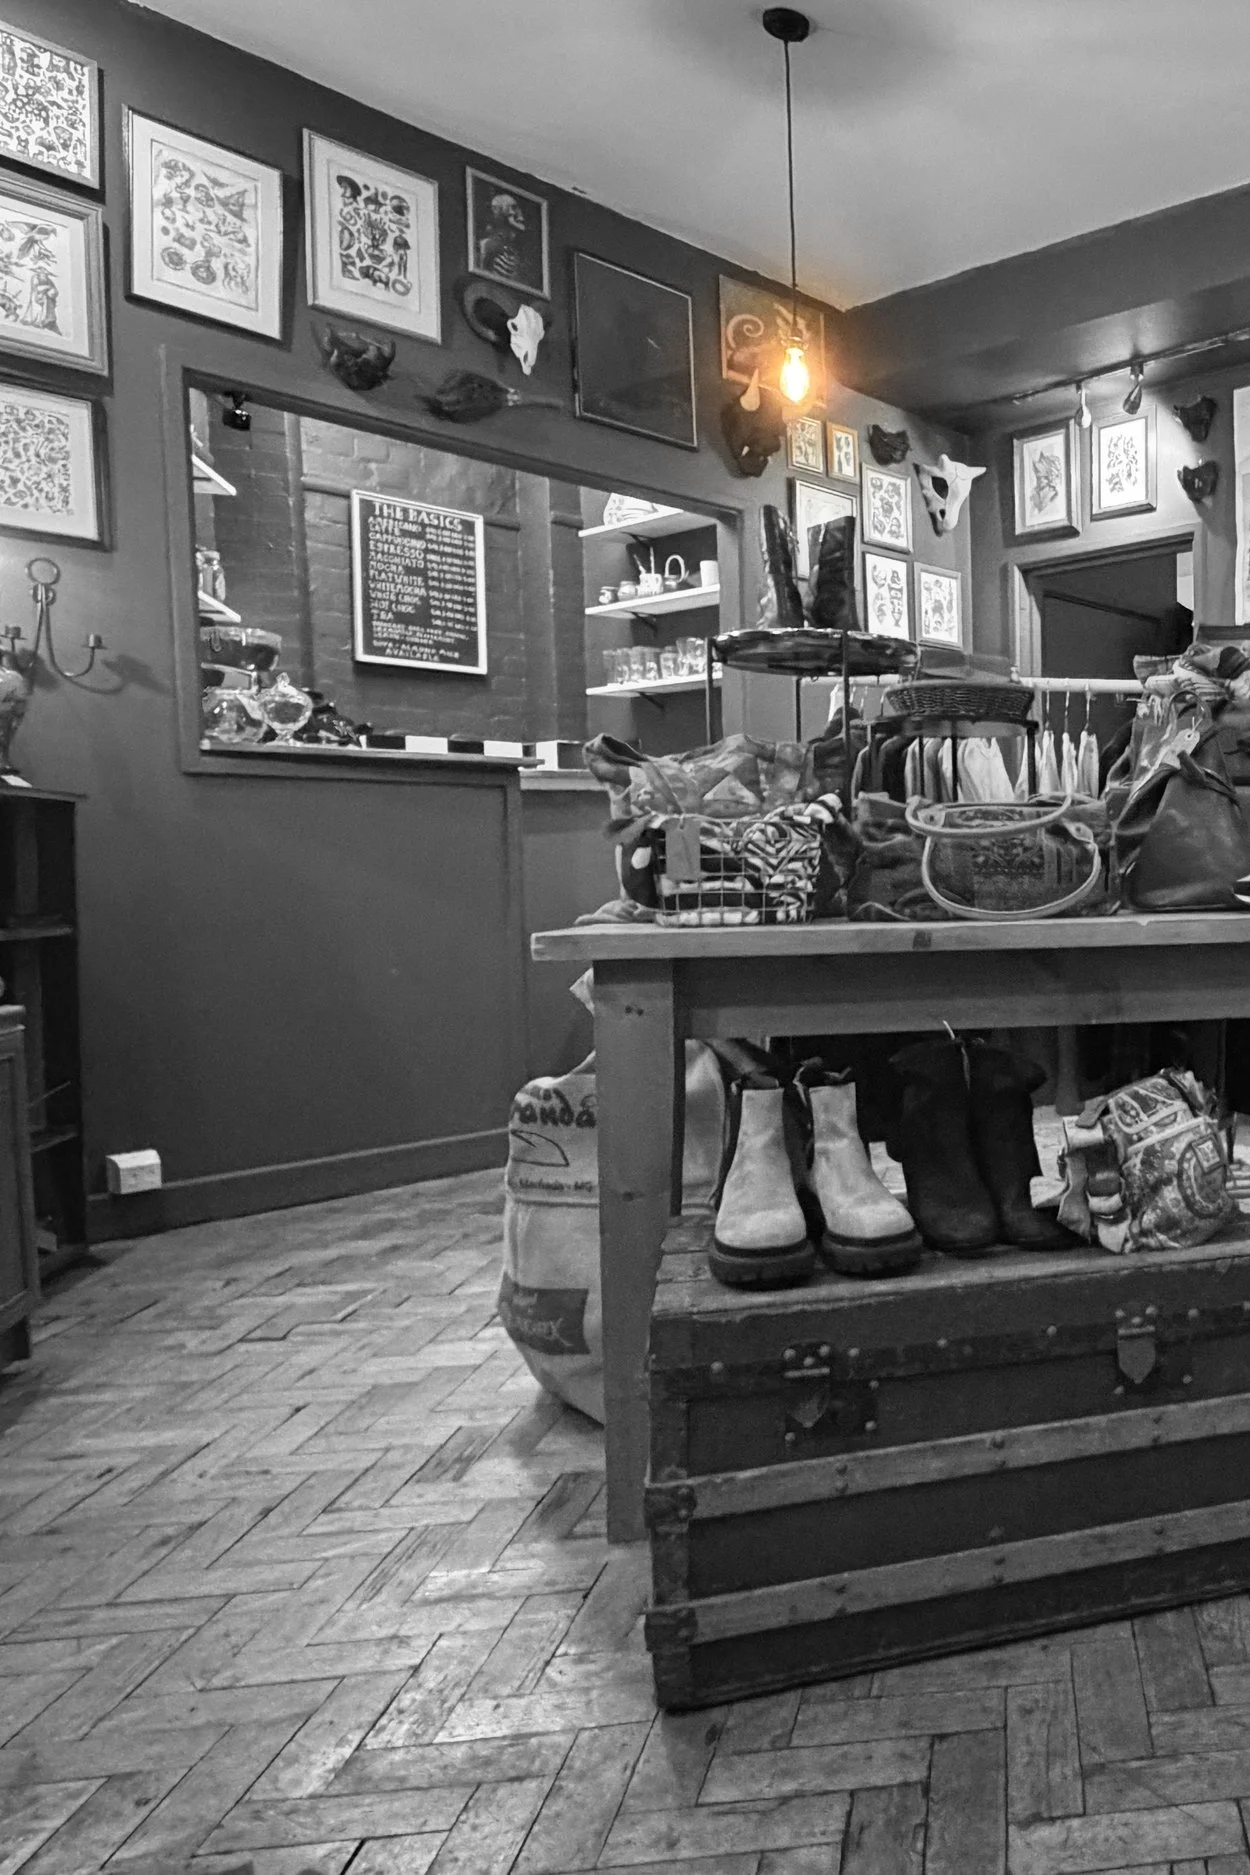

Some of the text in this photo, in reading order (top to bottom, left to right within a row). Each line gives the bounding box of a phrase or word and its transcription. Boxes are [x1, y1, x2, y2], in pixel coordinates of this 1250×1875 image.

[373, 502, 463, 531] THE BASICS
[369, 540, 424, 559] ESPRESSO
[369, 551, 424, 568] MACCHIATO
[369, 561, 404, 574] MOCHA
[371, 609, 394, 620] TEA
